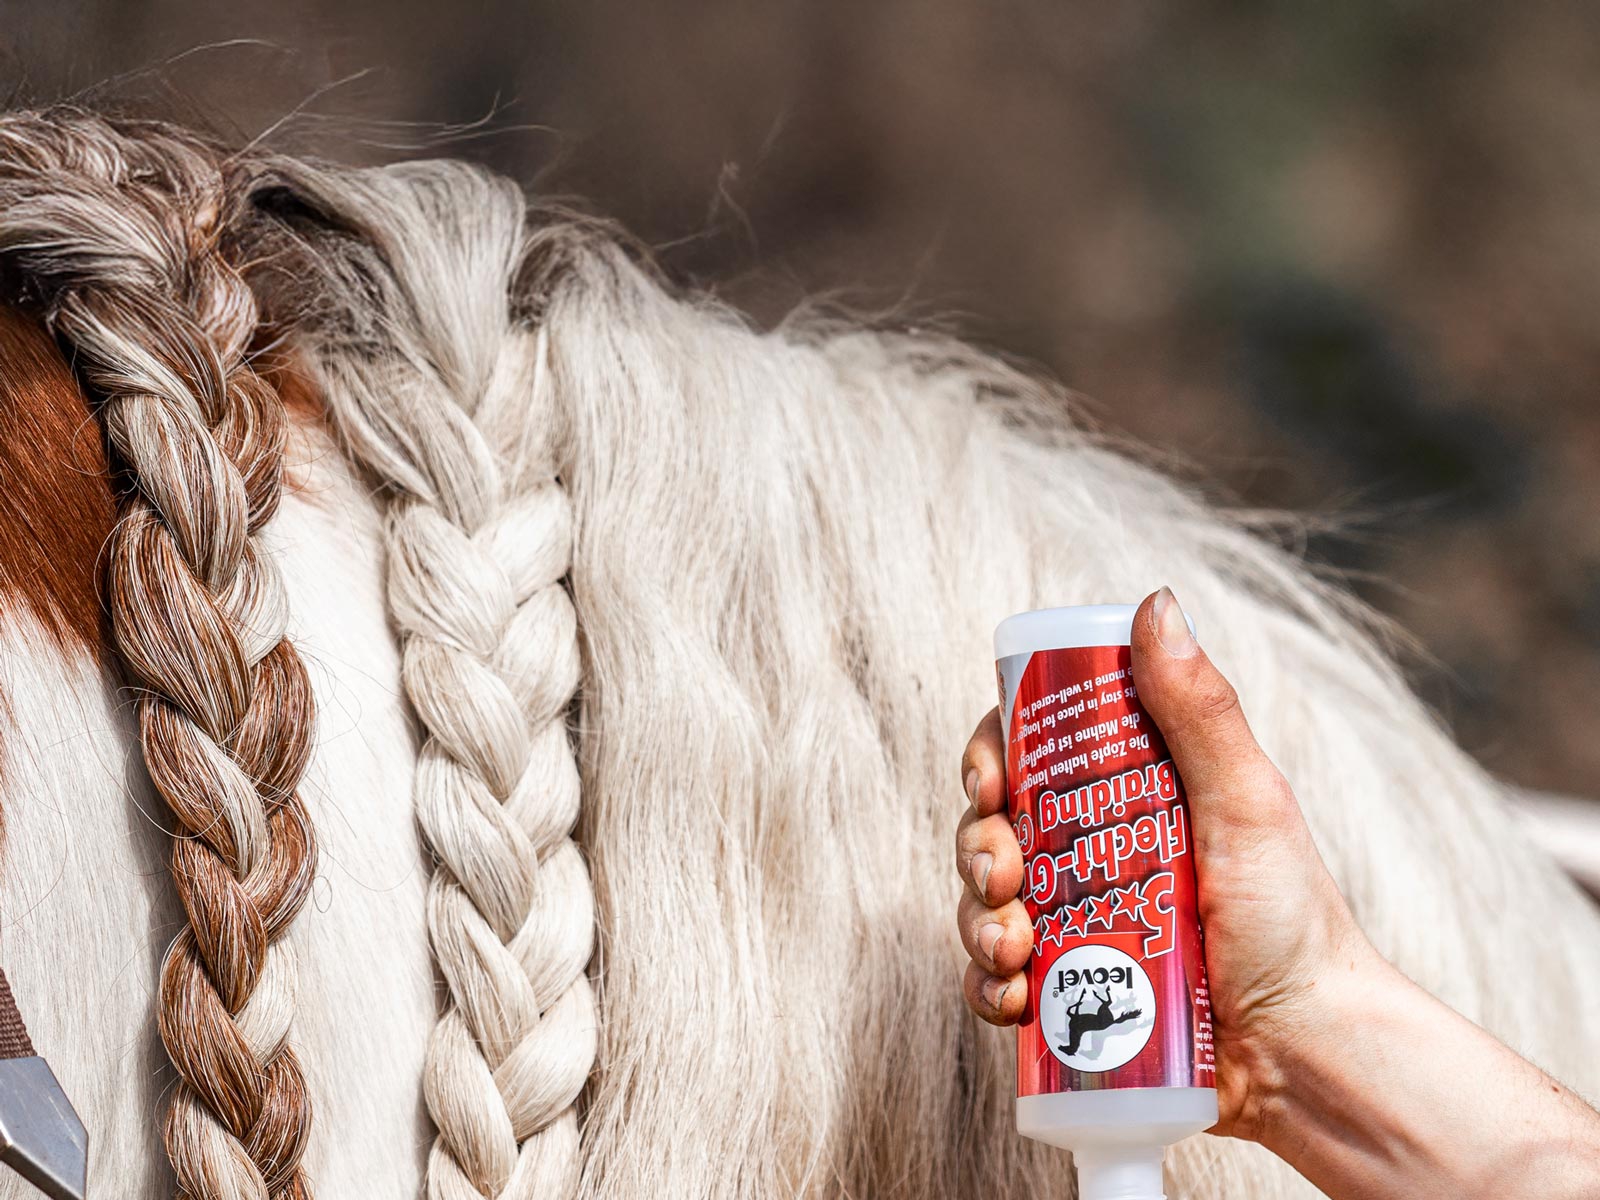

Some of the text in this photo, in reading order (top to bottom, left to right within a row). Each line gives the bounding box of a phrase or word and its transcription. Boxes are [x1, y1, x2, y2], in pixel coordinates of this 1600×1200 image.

[1083, 679, 1093, 692] is
[1095, 668, 1125, 687] mane
[1031, 684, 1082, 717] well-cared
[1101, 690, 1123, 706] stay
[1124, 685, 1137, 698] its
[1057, 700, 1085, 721] place
[1087, 698, 1099, 710] in
[1017, 720, 1041, 742] longer
[1042, 715, 1056, 728] for
[1018, 712, 1140, 772] die Mähne ist gepflegt
[1091, 740, 1128, 764] Zöpfe
[1129, 733, 1150, 750] Die
[1050, 753, 1089, 777] halten
[1020, 769, 1049, 794] länger
[1038, 759, 1177, 833] Braiding
[1021, 804, 1187, 905] Flecht-Gr
[1138, 871, 1177, 959] 5
